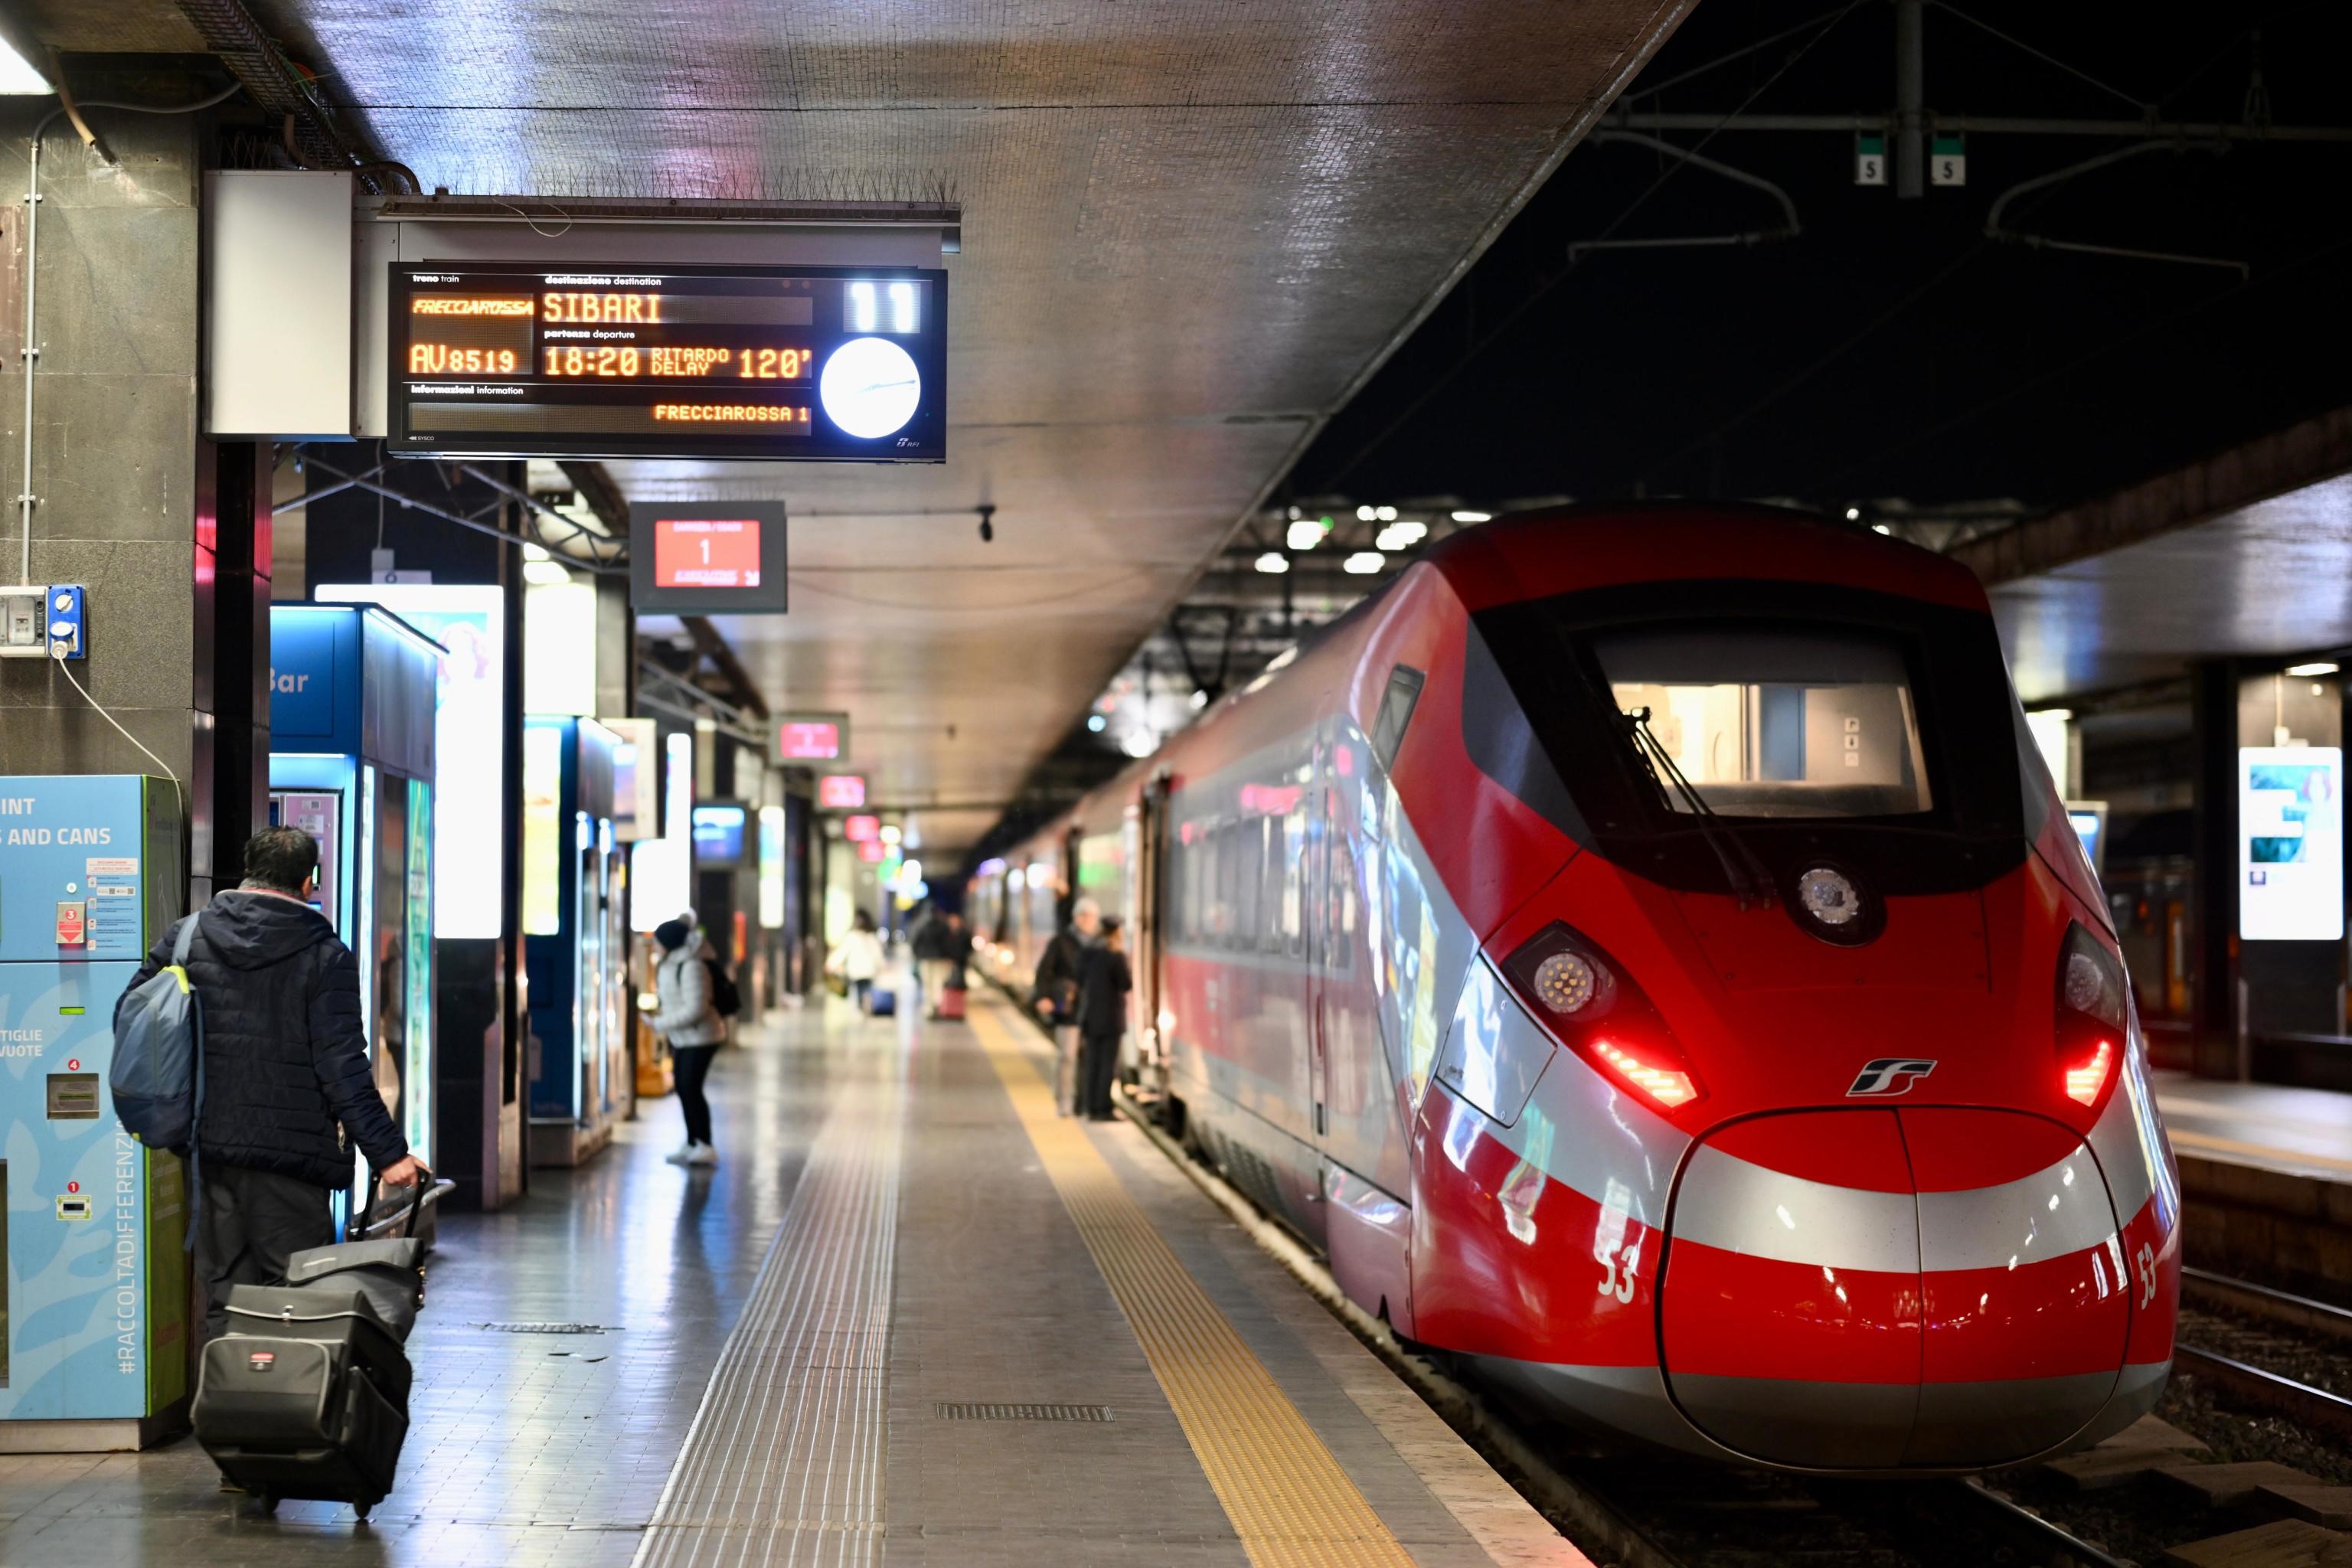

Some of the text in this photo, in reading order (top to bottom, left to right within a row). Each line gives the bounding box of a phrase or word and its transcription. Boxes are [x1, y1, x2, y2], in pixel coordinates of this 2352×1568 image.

[413, 274, 439, 283] treno
[544, 275, 662, 286] destinazione destination
[412, 299, 534, 316] FRECCIAROSSA
[544, 292, 661, 324] SIBARI
[851, 281, 913, 333] 11
[544, 329, 635, 340] partenza departure
[546, 346, 639, 377] 18:20
[651, 348, 730, 362] RITARDO
[651, 361, 710, 376] DELAY
[411, 384, 524, 395] informazioni information
[655, 405, 808, 421] FRECCIAROSSA 1
[700, 538, 710, 565] 1
[8, 828, 51, 845] AND
[57, 827, 111, 845] CANS
[0, 1029, 44, 1042] TIGLIE
[1594, 1238, 1635, 1304] 53
[2137, 1242, 2157, 1311] 53
